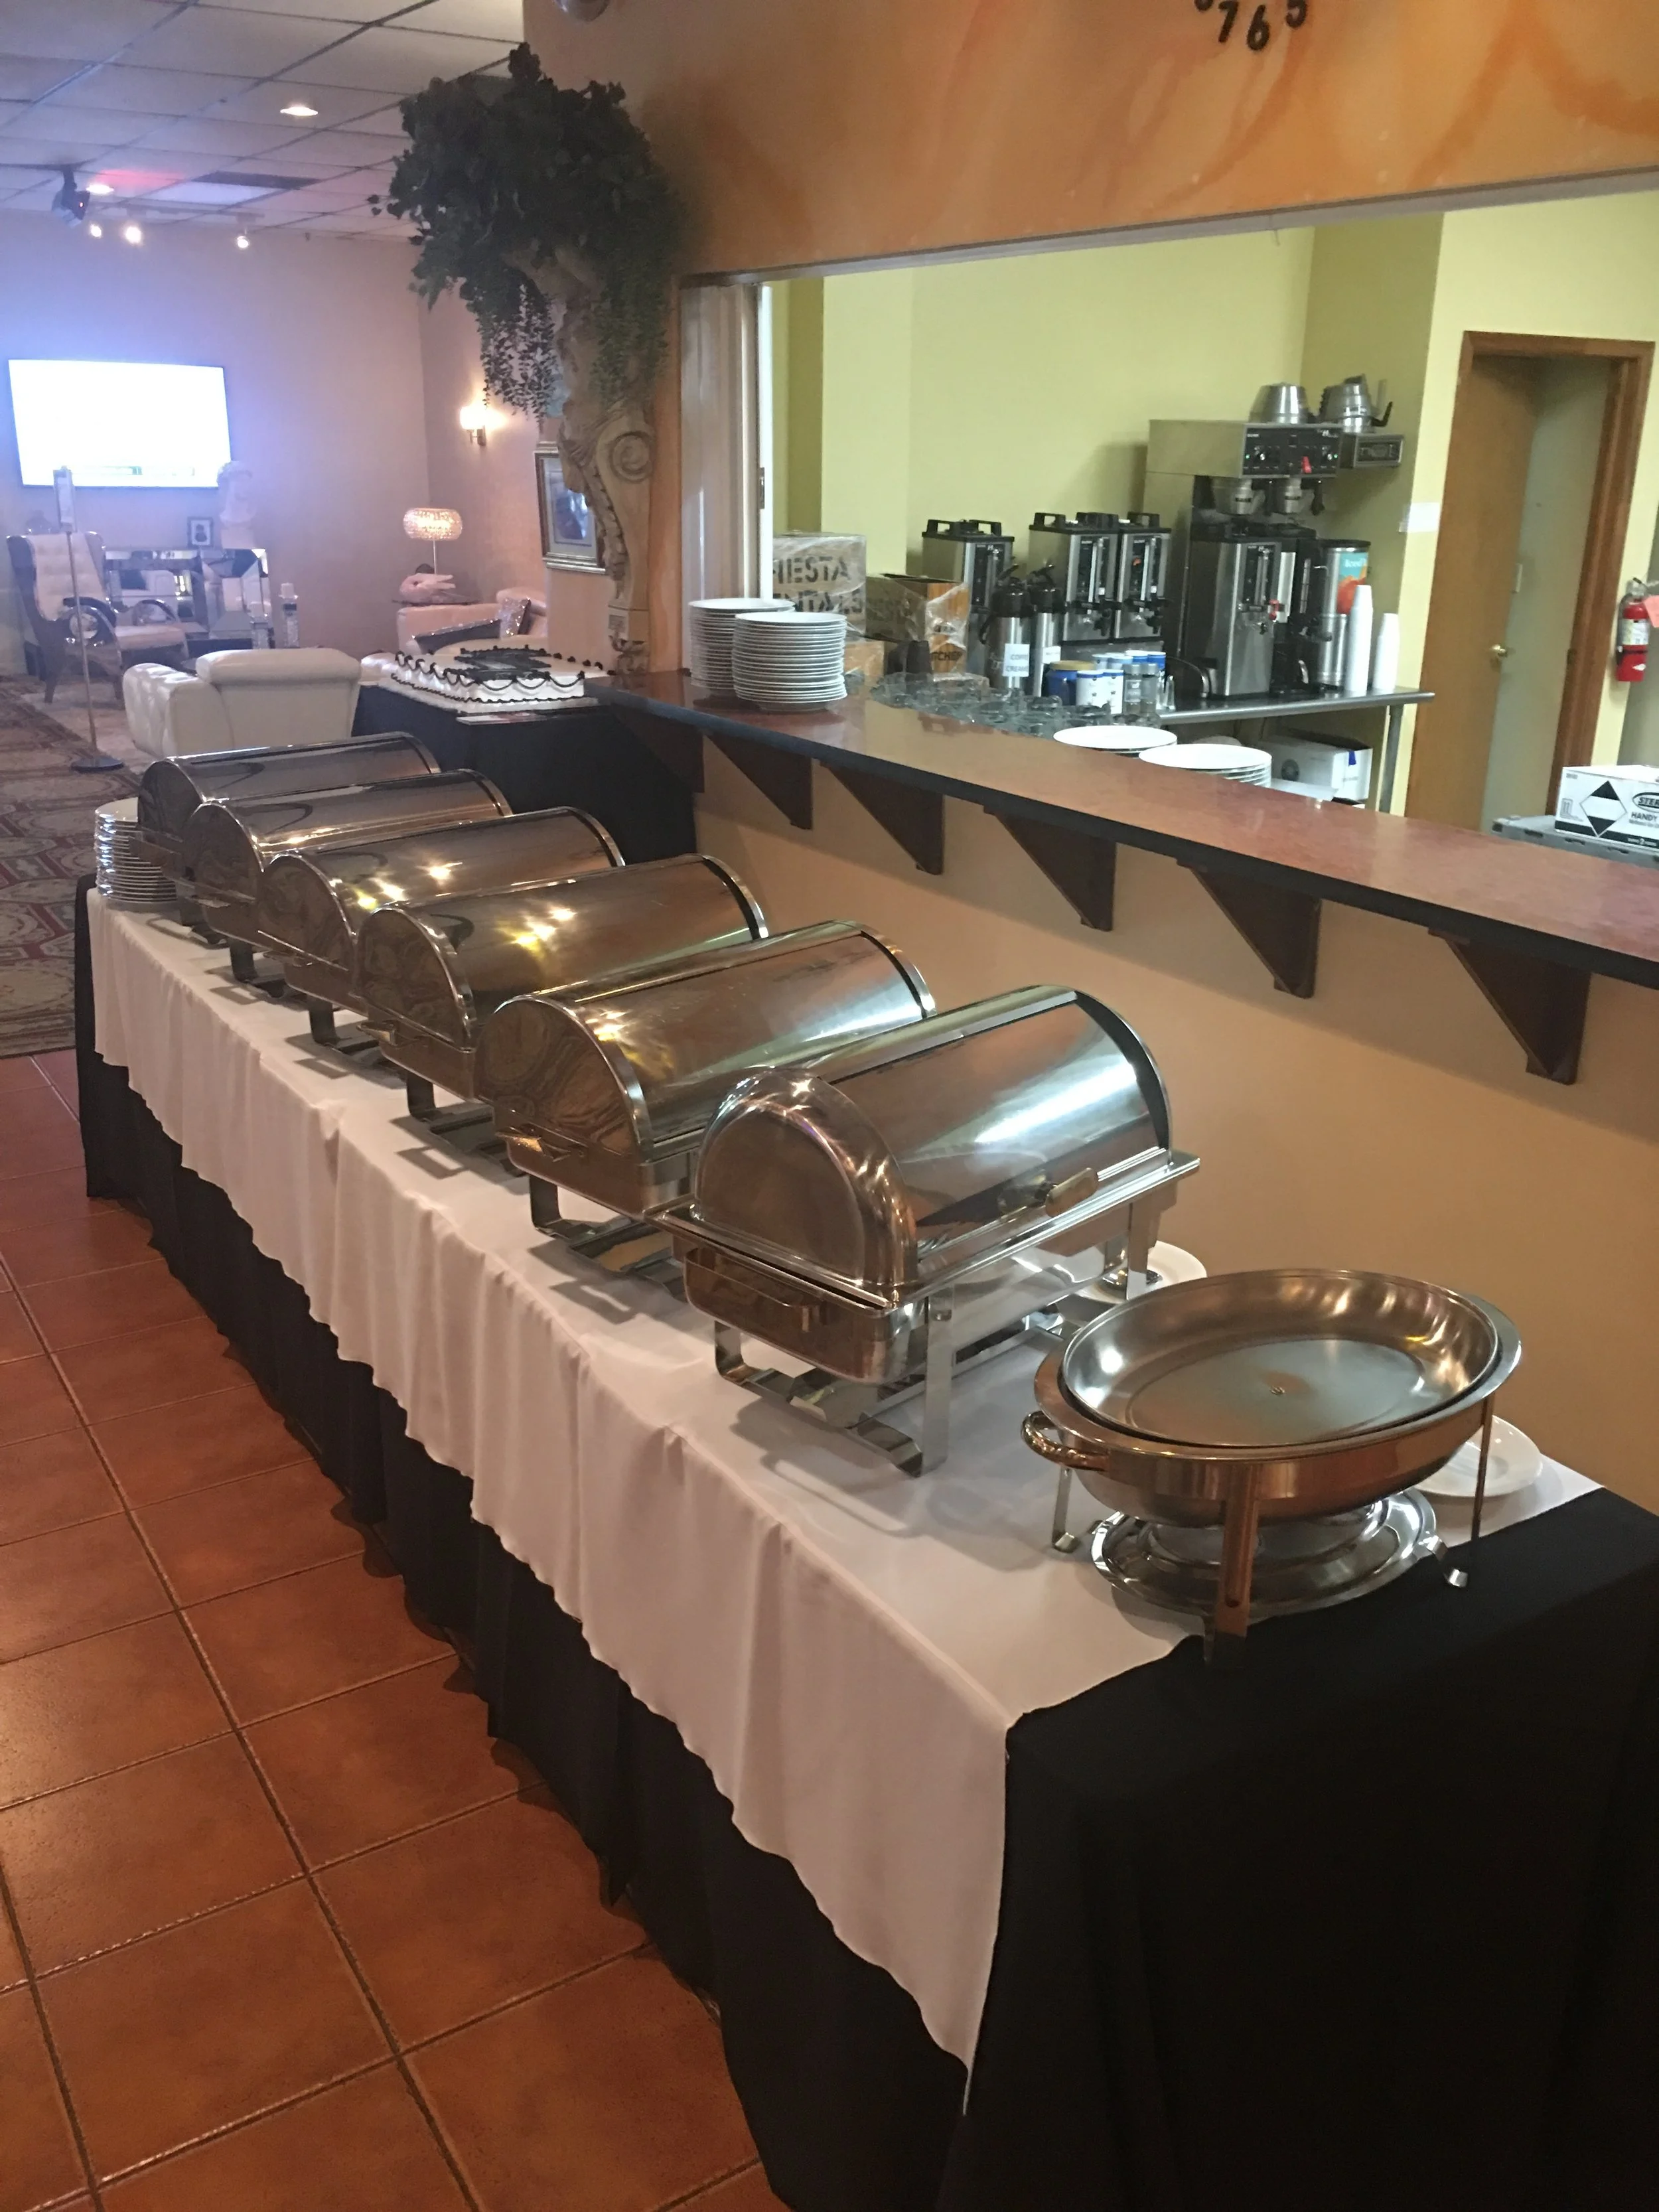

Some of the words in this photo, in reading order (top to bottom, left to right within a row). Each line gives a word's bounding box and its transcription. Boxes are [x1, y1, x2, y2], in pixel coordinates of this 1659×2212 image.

[1218, 1, 1239, 43] 7
[1247, 5, 1270, 50] 6
[772, 556, 851, 584] IESTA
[1630, 811, 1658, 822] HANDY
